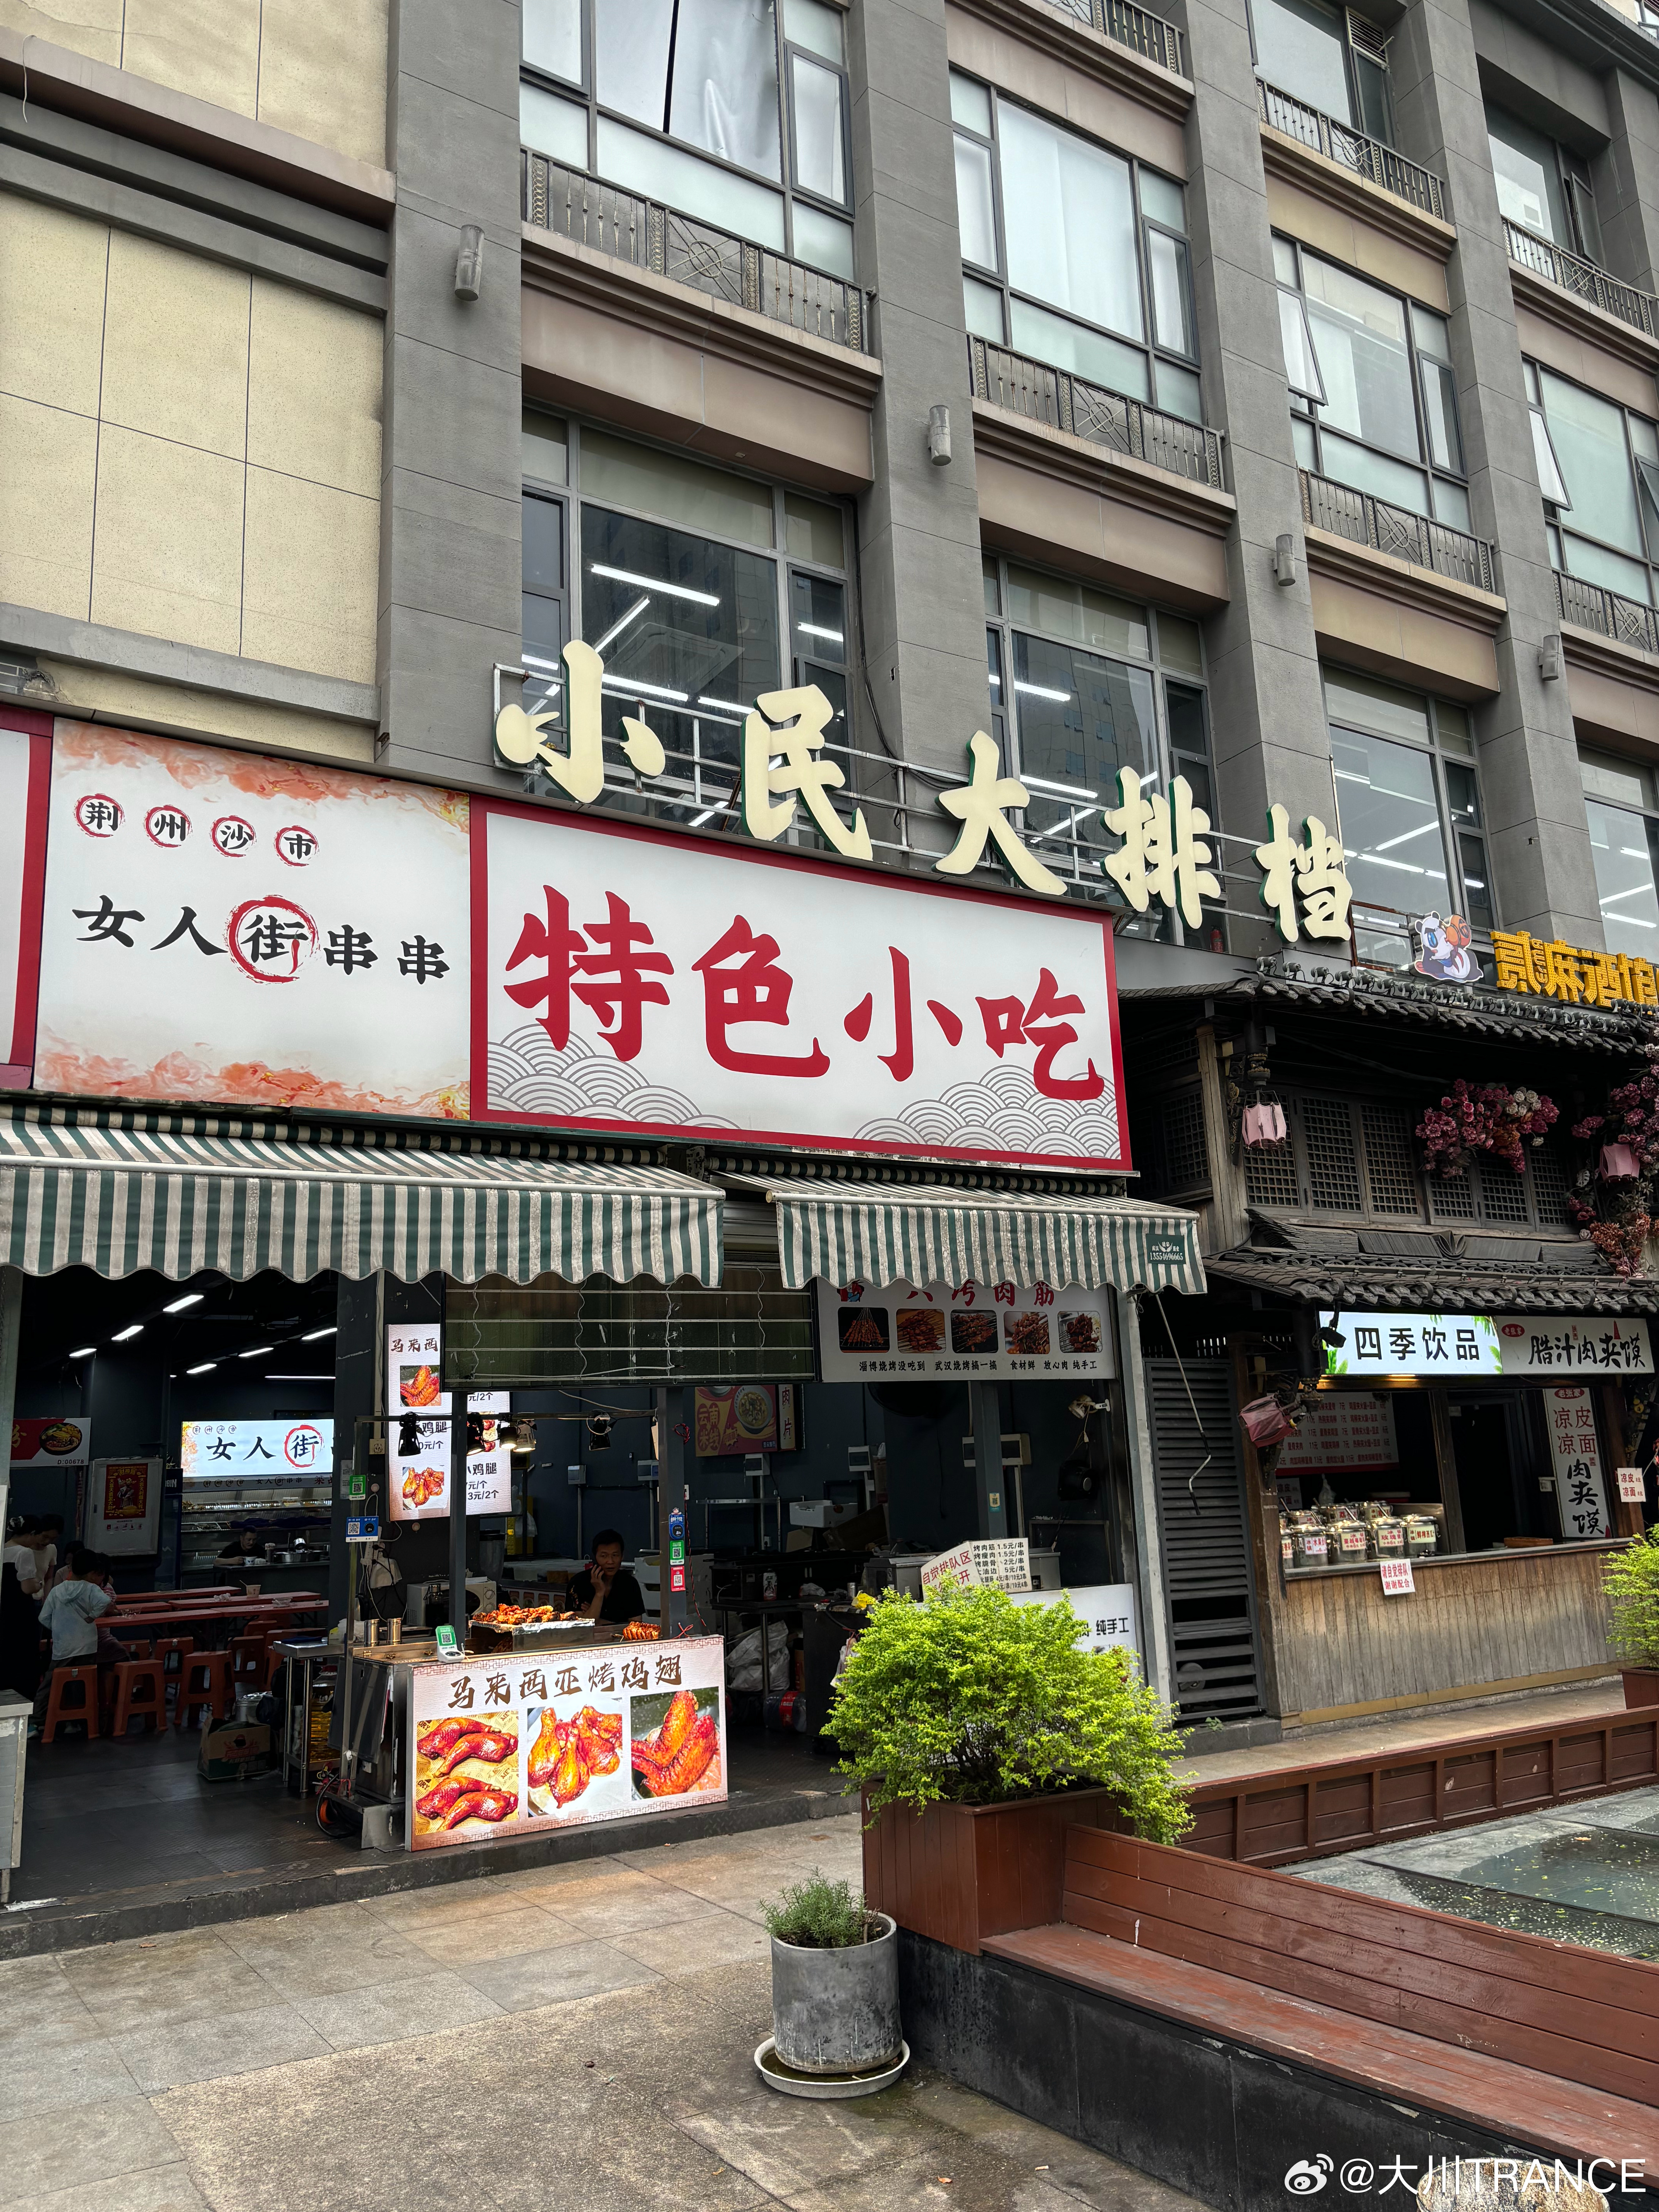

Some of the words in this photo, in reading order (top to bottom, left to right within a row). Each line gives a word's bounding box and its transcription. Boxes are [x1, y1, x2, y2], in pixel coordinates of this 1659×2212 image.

[494, 639, 1353, 943] 小民大排档
[84, 800, 316, 860] 荆州沙市
[72, 895, 450, 985] 女人街串串
[505, 884, 1104, 1100] 特色小吃
[391, 1338, 438, 1353] 马来西
[1355, 1327, 1480, 1361] 四季饮品
[1528, 1332, 1645, 1369] 腊汁肉夹馍
[859, 1360, 926, 1371] 淄博烧烤没吃到
[935, 1360, 997, 1371] 武汉烧烤搞一搞
[1010, 1360, 1036, 1370] 食材鲜
[1044, 1360, 1068, 1370] 放心肉
[1073, 1360, 1097, 1370] 纯手工
[699, 1405, 719, 1425] 云南
[1553, 1406, 1594, 1429] 凉皮
[193, 1425, 237, 1434] 荆州沙市
[417, 1421, 447, 1434] 鸡腿
[206, 1434, 333, 1462] 女人街
[1557, 1433, 1597, 1455] 凉面
[467, 1462, 498, 1475] 鸡腿
[1621, 1473, 1634, 1483] 凉皮
[1567, 1458, 1604, 1535] 肉夹馍
[1623, 1487, 1636, 1497] 凉面
[1417, 1530, 1434, 1539] 鲜榨西瓜
[922, 1550, 972, 1585] 自觉排队区
[1005, 1565, 1025, 1573] 5元/串
[1096, 1617, 1129, 1635] 纯手工
[448, 1654, 683, 1709] 马来西亚烤鸡翅
